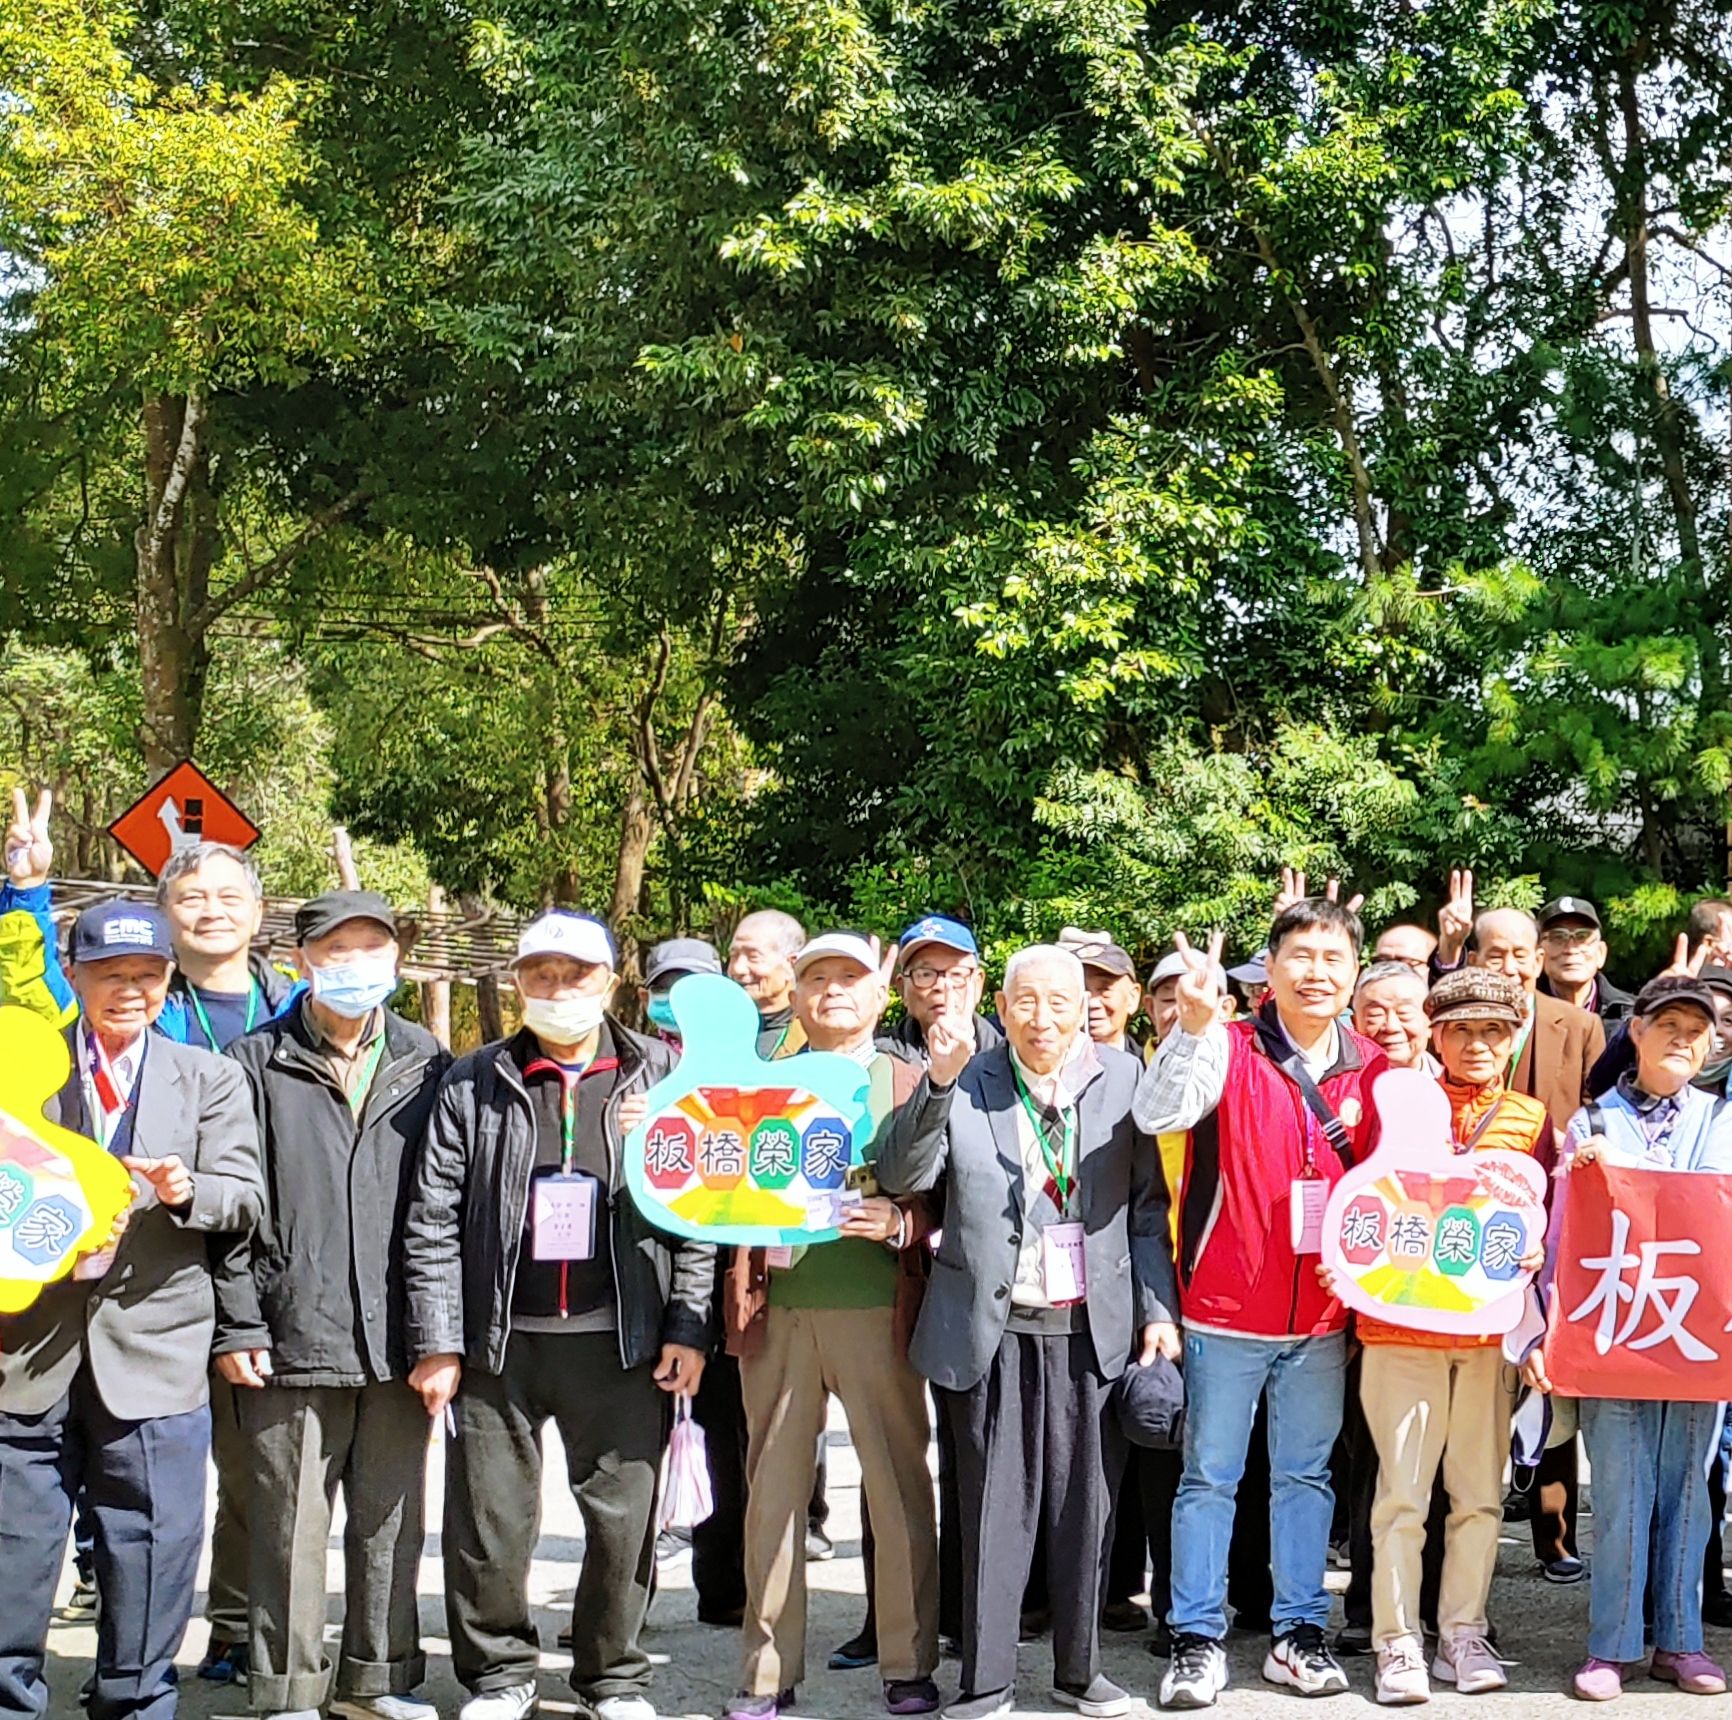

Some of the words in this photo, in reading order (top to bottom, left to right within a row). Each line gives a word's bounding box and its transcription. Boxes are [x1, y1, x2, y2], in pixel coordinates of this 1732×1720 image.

[647, 1129, 848, 1177] 板橋榮家
[1342, 1206, 1522, 1270] 板橋榮家
